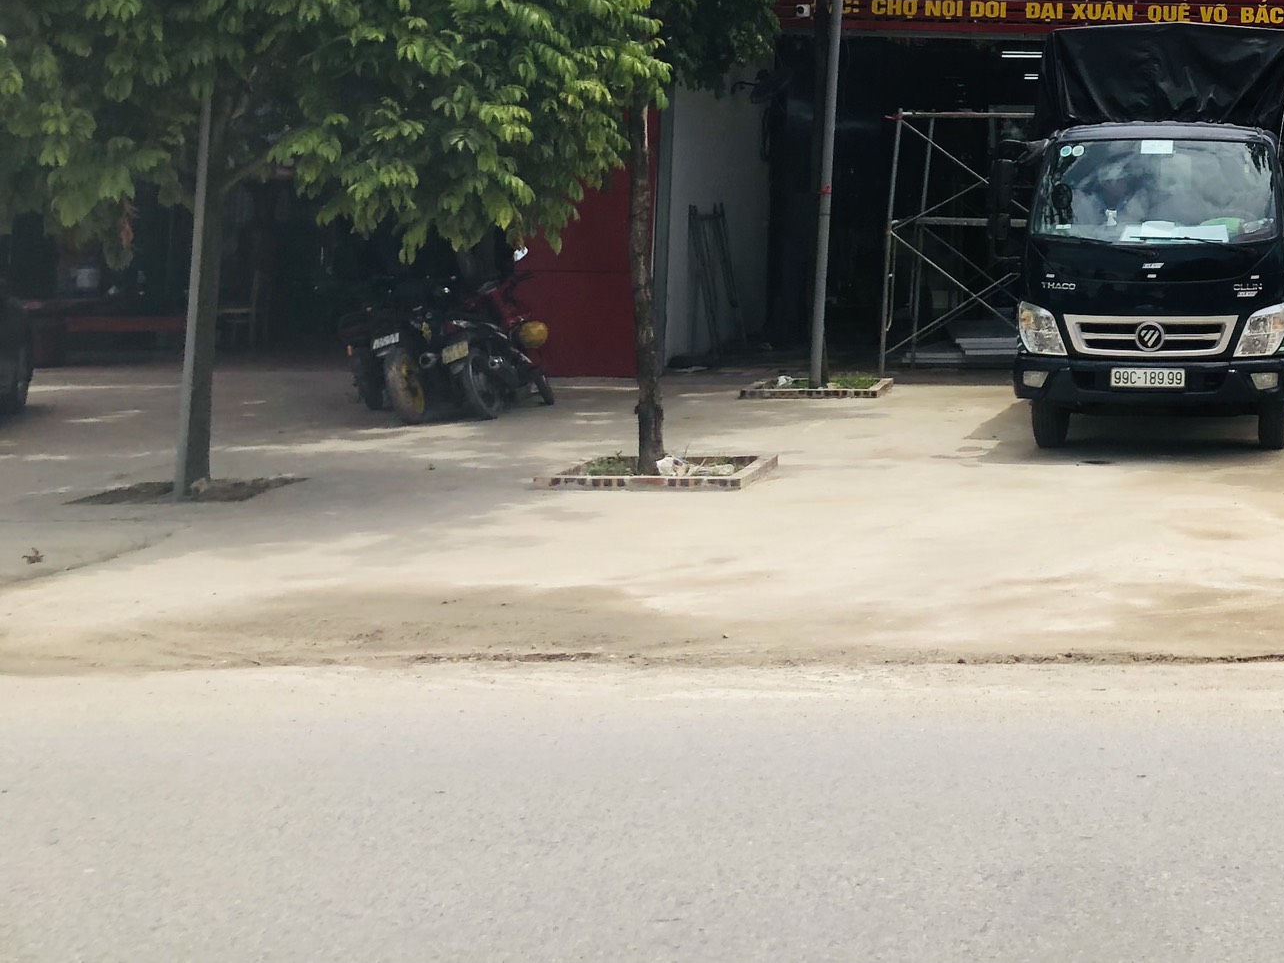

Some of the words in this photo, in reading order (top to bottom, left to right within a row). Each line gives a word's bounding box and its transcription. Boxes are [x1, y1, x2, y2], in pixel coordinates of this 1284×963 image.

[1025, 2, 1063, 21] ĐẠI
[1071, 1, 1134, 22] XUÂN
[1200, 4, 1229, 23] VÕ
[1041, 281, 1077, 291] THACO
[1114, 370, 1183, 385] 99C-189.99
